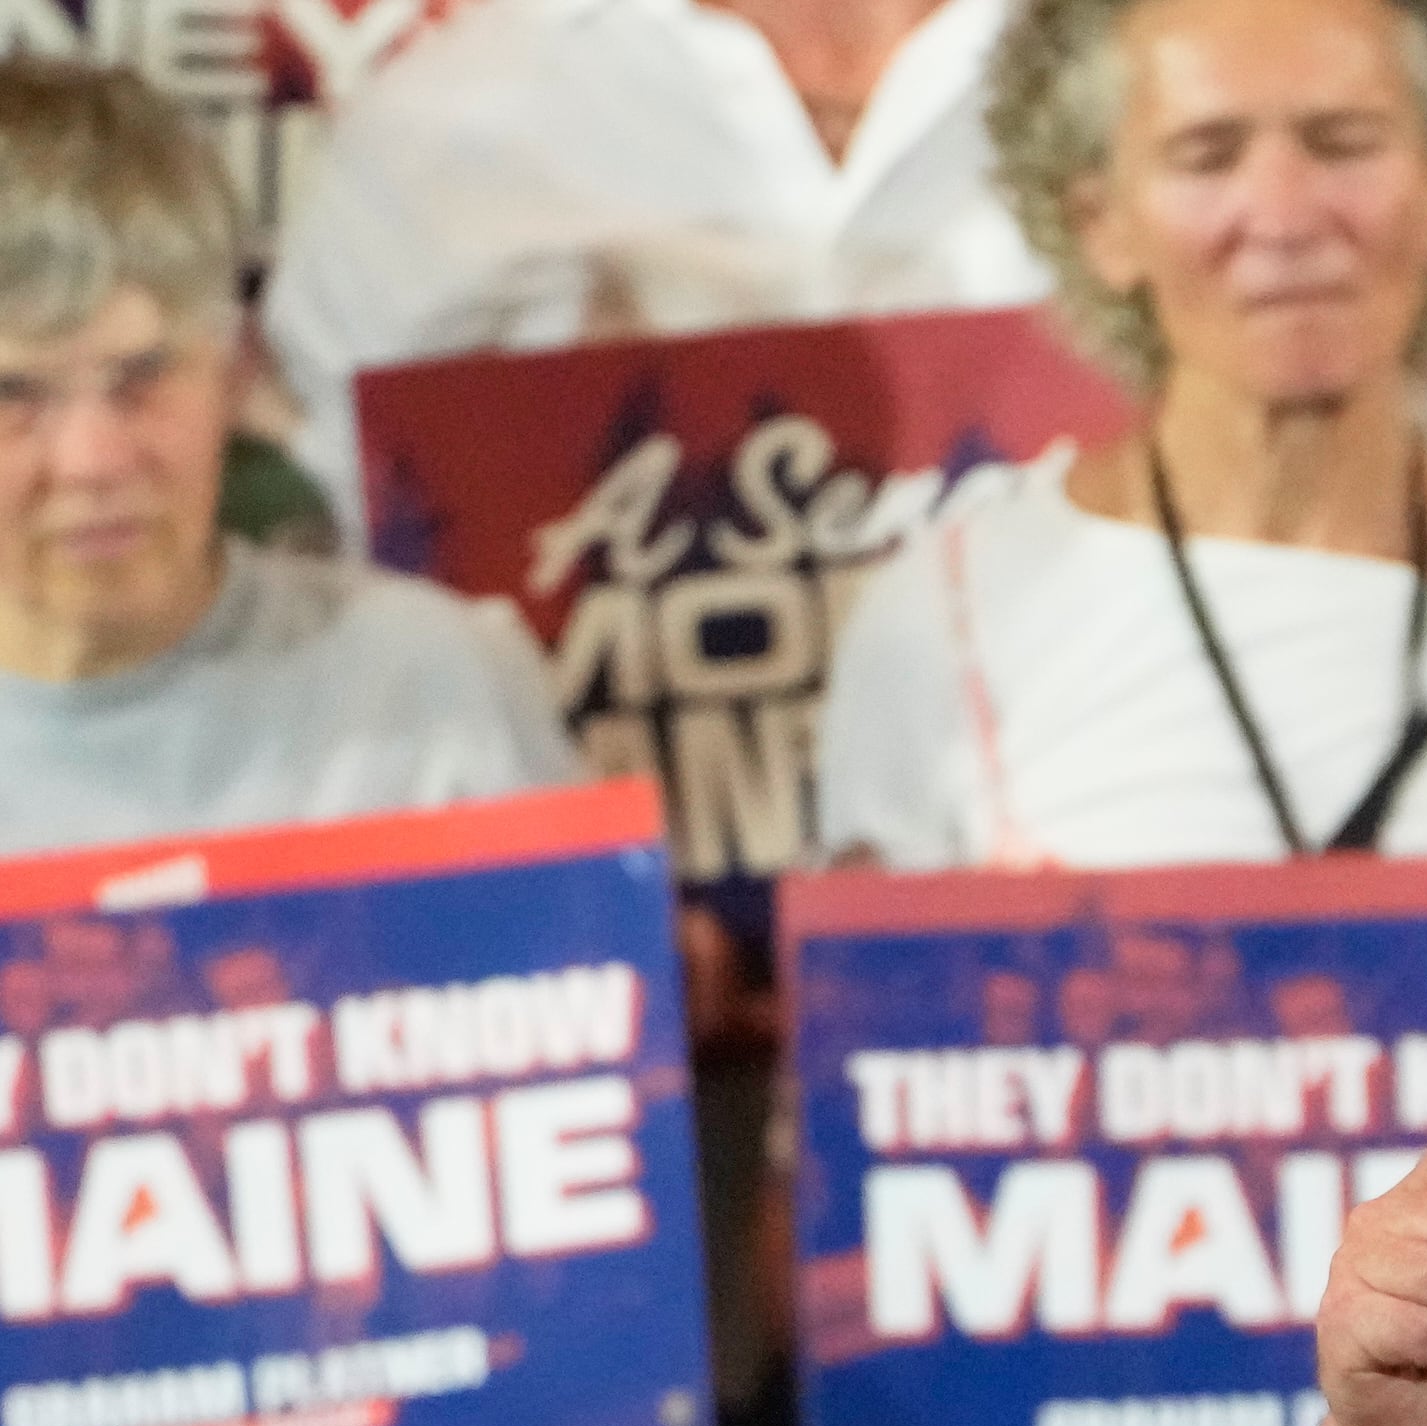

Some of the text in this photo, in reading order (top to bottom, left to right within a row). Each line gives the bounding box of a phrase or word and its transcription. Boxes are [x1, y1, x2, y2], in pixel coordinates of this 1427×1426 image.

[38, 1000, 324, 1130] DON'T
[332, 960, 640, 1094] KNOW
[848, 1044, 1085, 1151] THEY
[1100, 1035, 1383, 1140] DON'T
